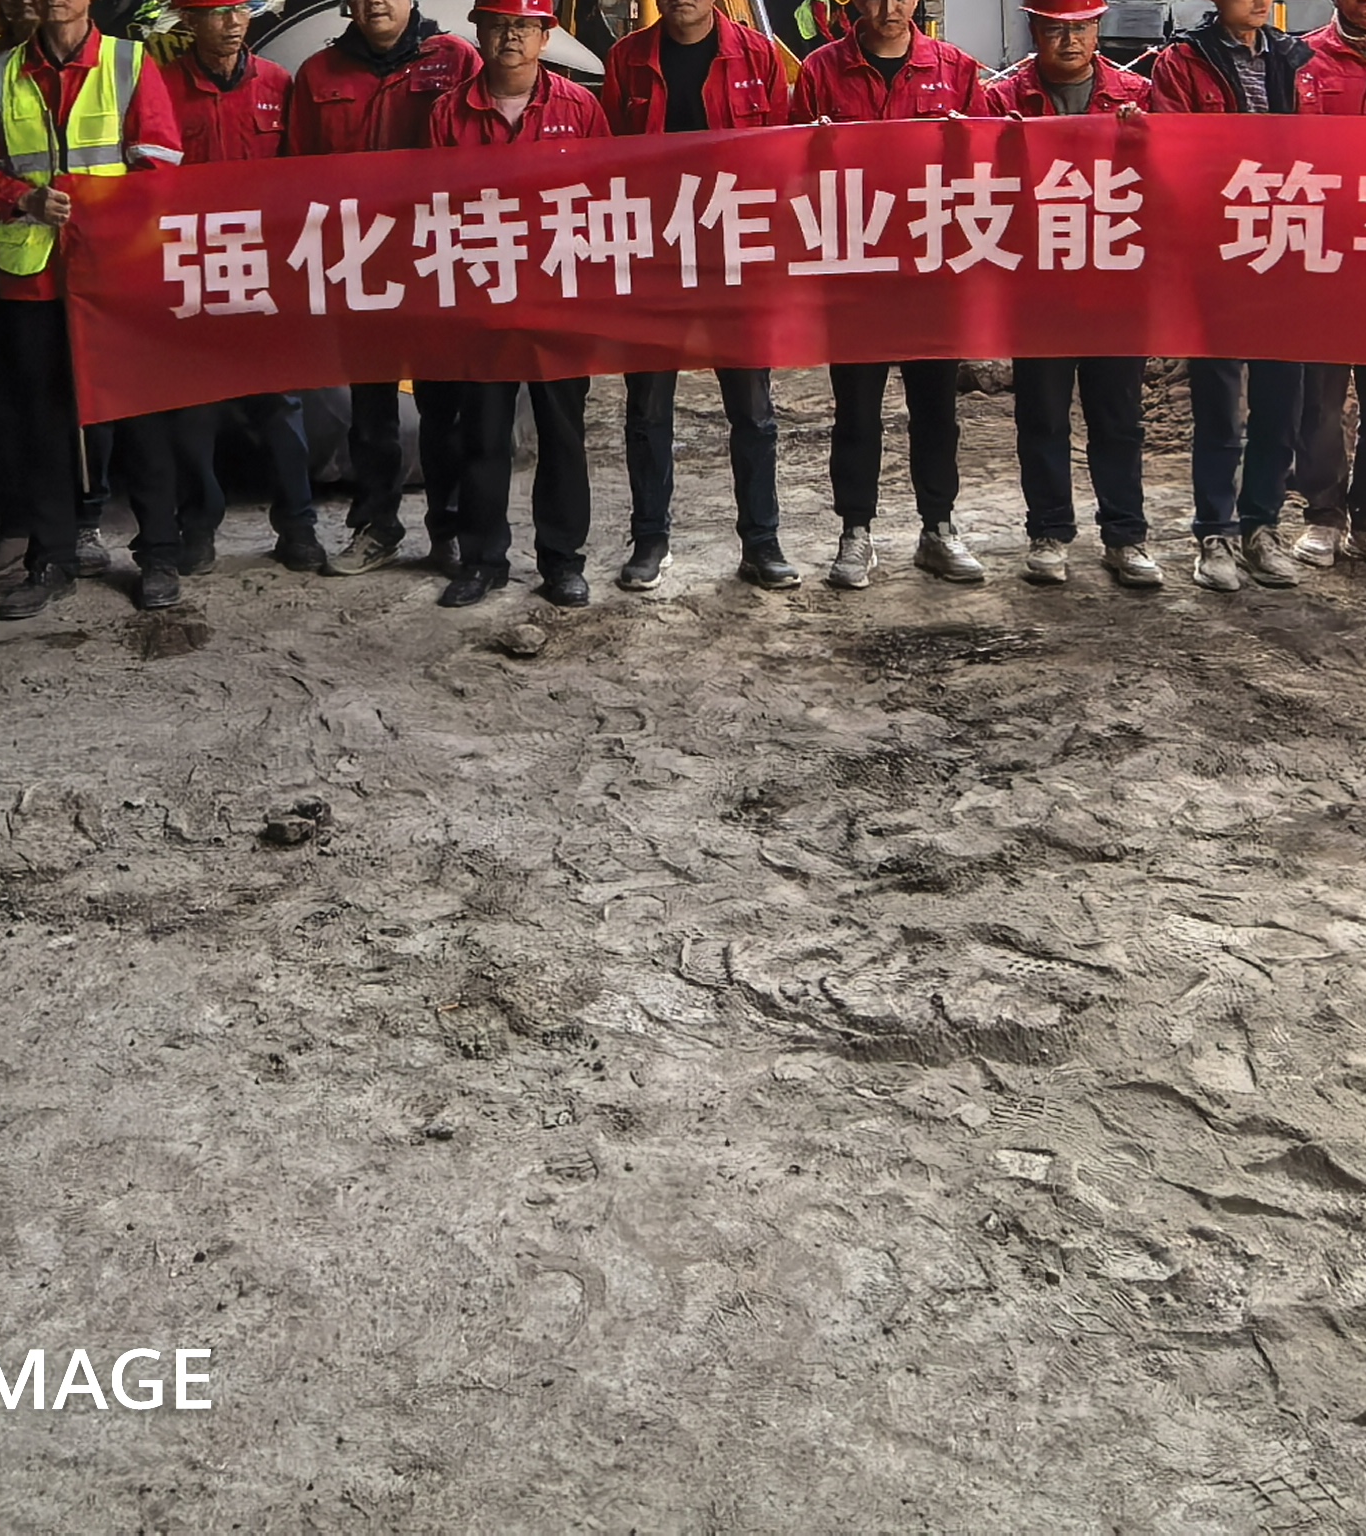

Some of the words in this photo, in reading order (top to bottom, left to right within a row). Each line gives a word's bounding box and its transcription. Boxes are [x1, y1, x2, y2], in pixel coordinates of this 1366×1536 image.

[159, 159, 1143, 318] 强化特种作业技能
